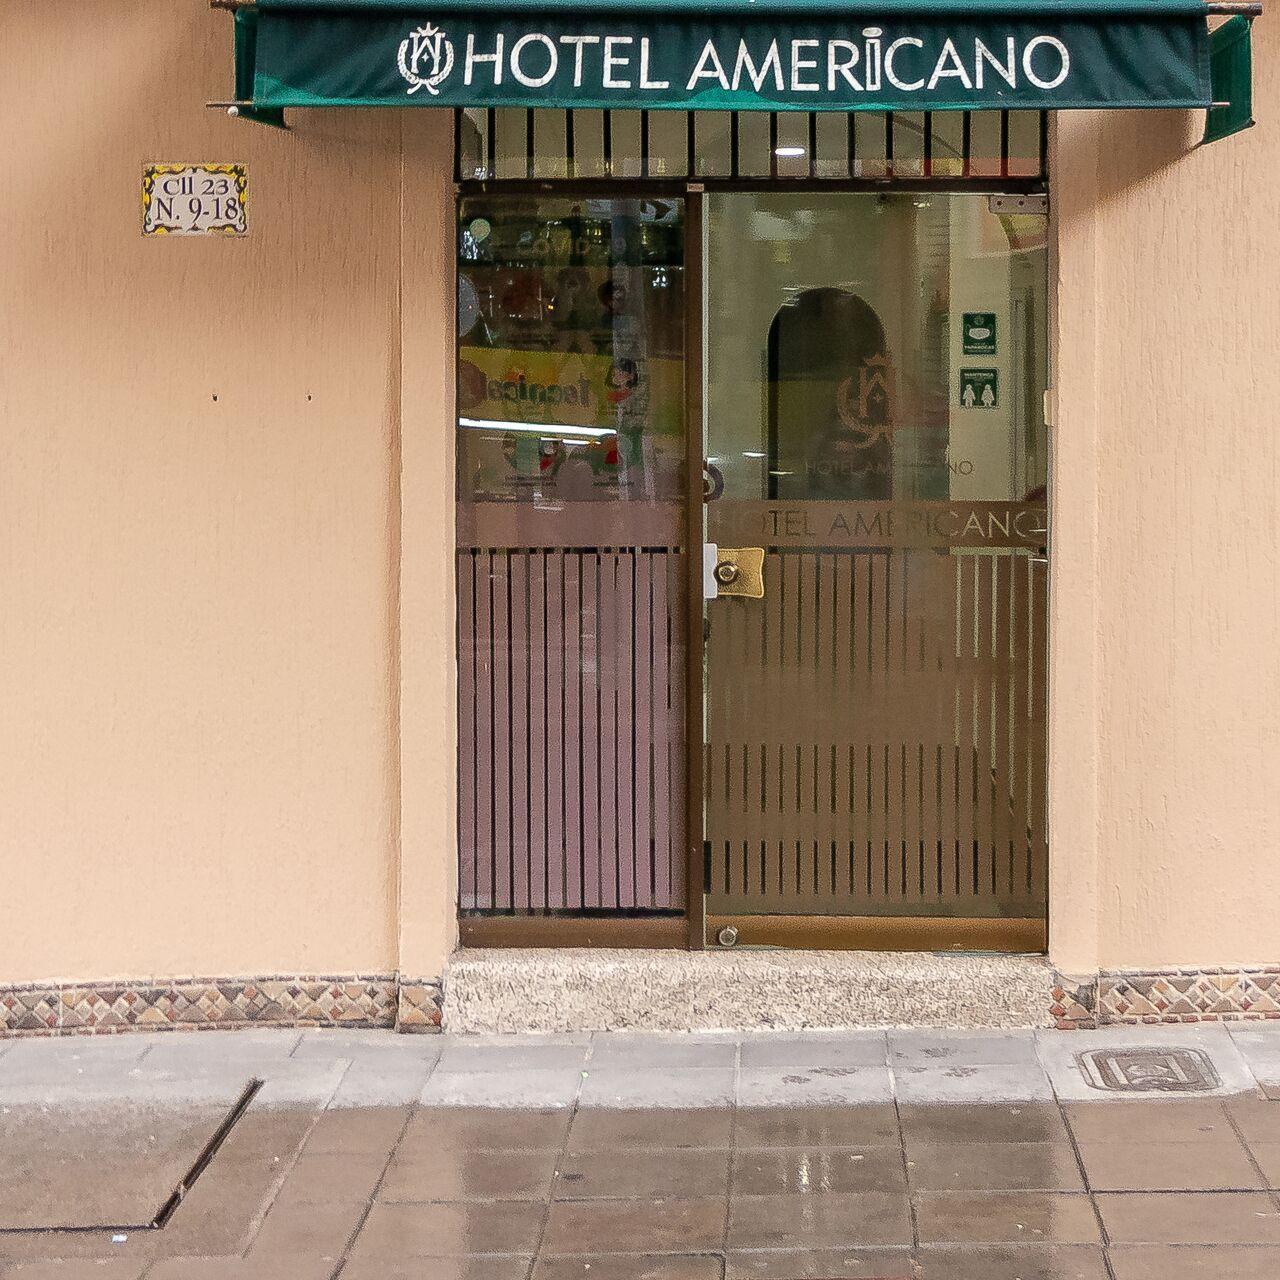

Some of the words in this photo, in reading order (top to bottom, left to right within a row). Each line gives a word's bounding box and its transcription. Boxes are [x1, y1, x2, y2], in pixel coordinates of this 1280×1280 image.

[464, 33, 669, 90] HOTEL
[201, 179, 229, 195] 23
[155, 197, 180, 220] N.
[189, 197, 238, 223] 9-18
